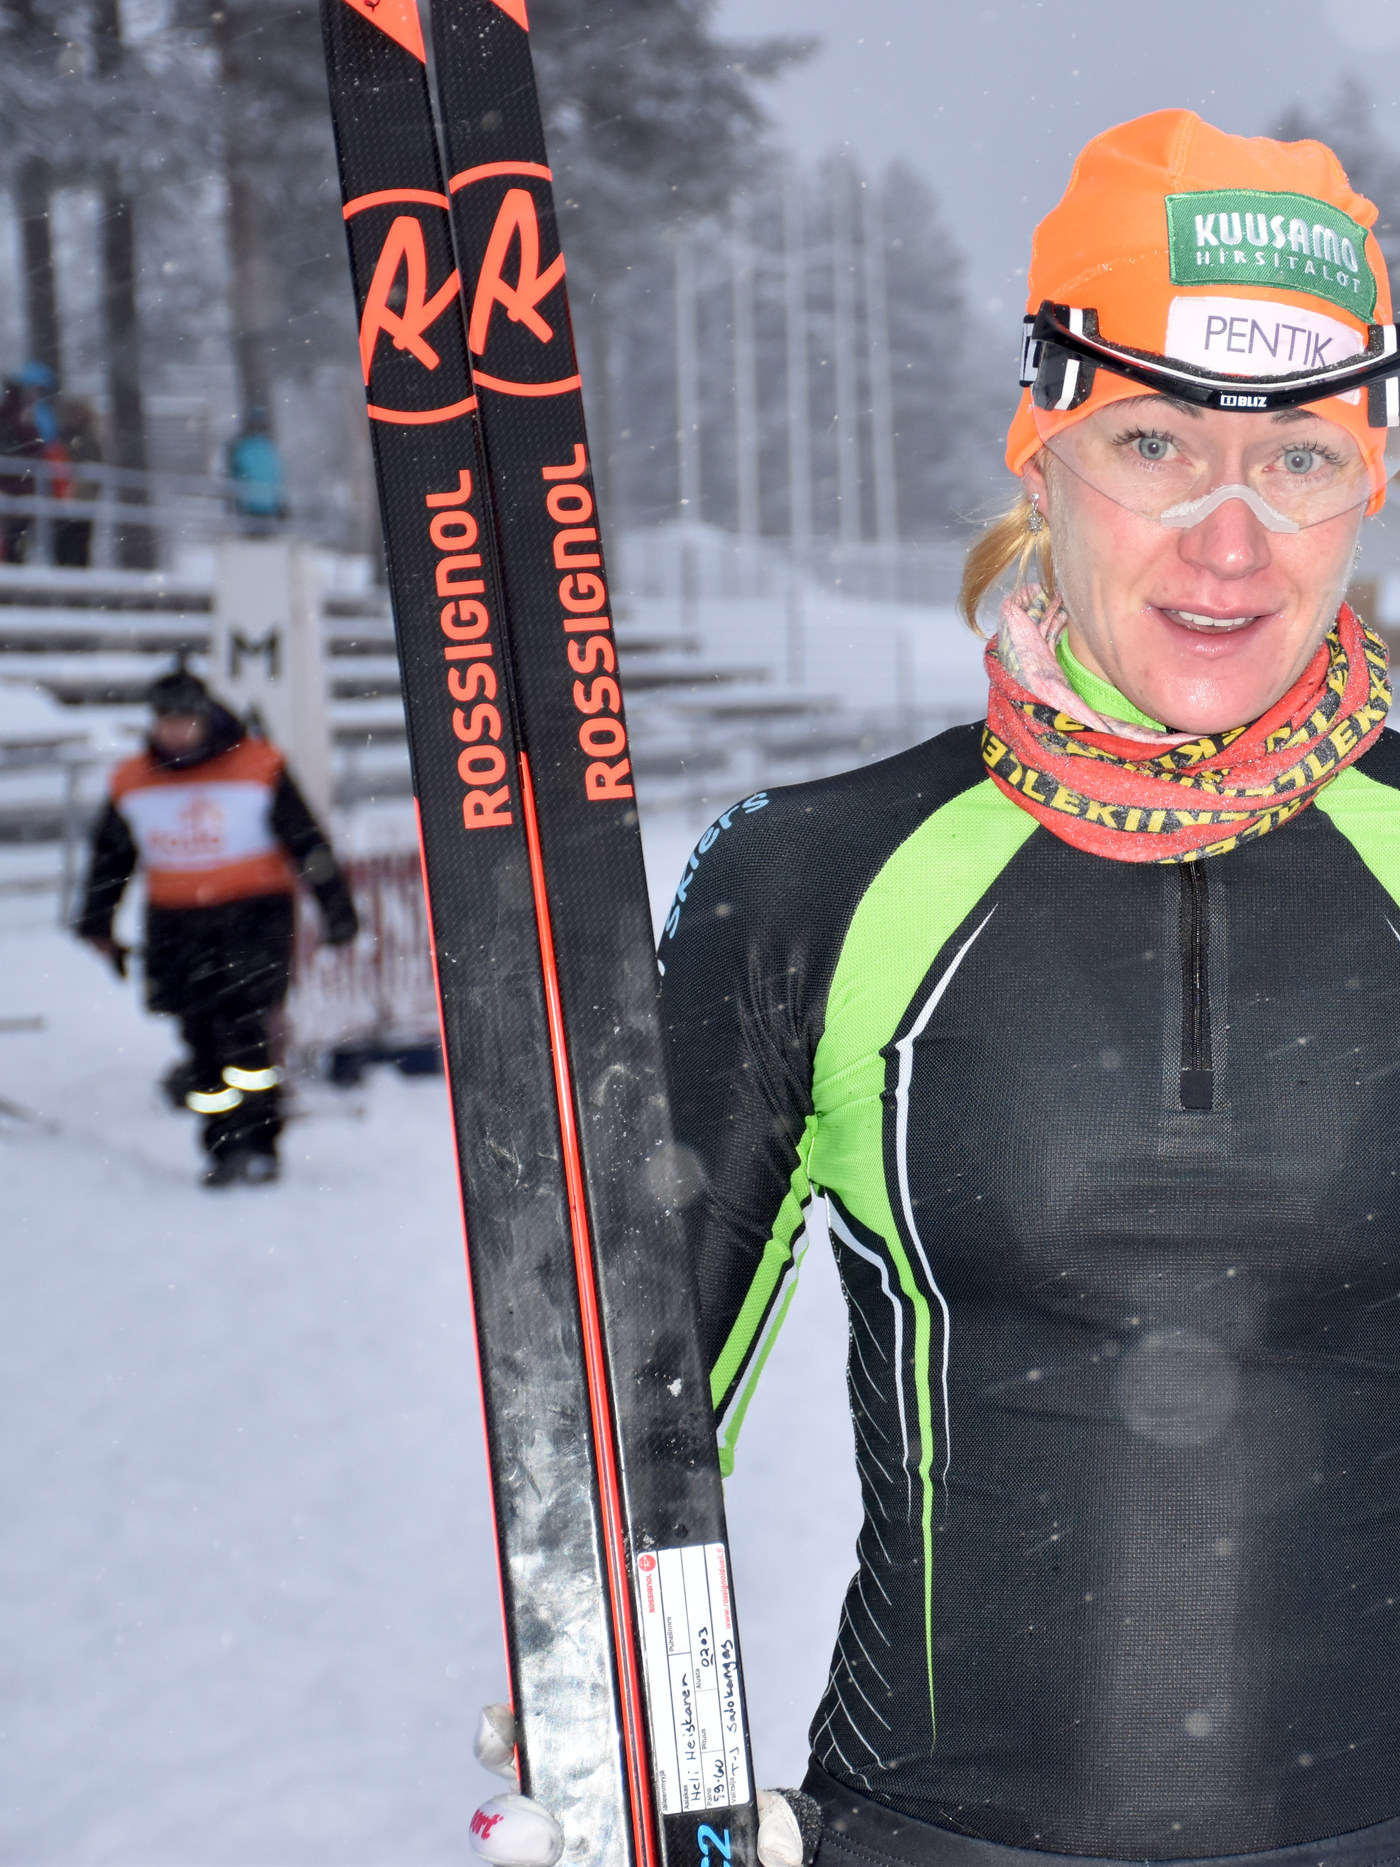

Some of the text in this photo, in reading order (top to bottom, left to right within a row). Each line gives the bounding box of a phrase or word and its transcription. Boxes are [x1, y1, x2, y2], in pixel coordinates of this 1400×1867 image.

[1194, 212, 1359, 273] KUUSAMO
[1195, 250, 1362, 294] HIRSITALOT
[1204, 315, 1334, 368] PENTIK
[1237, 395, 1268, 408] BLIZ
[542, 443, 634, 801] ROSSIGNOL
[425, 469, 513, 829] ROSSIGNOL
[645, 1573, 656, 1614] ROSSIGNOL
[666, 1616, 675, 1652] Puhelinnro
[680, 1672, 702, 1802] Heli Heiskanen
[729, 1777, 737, 1803] Valitsija
